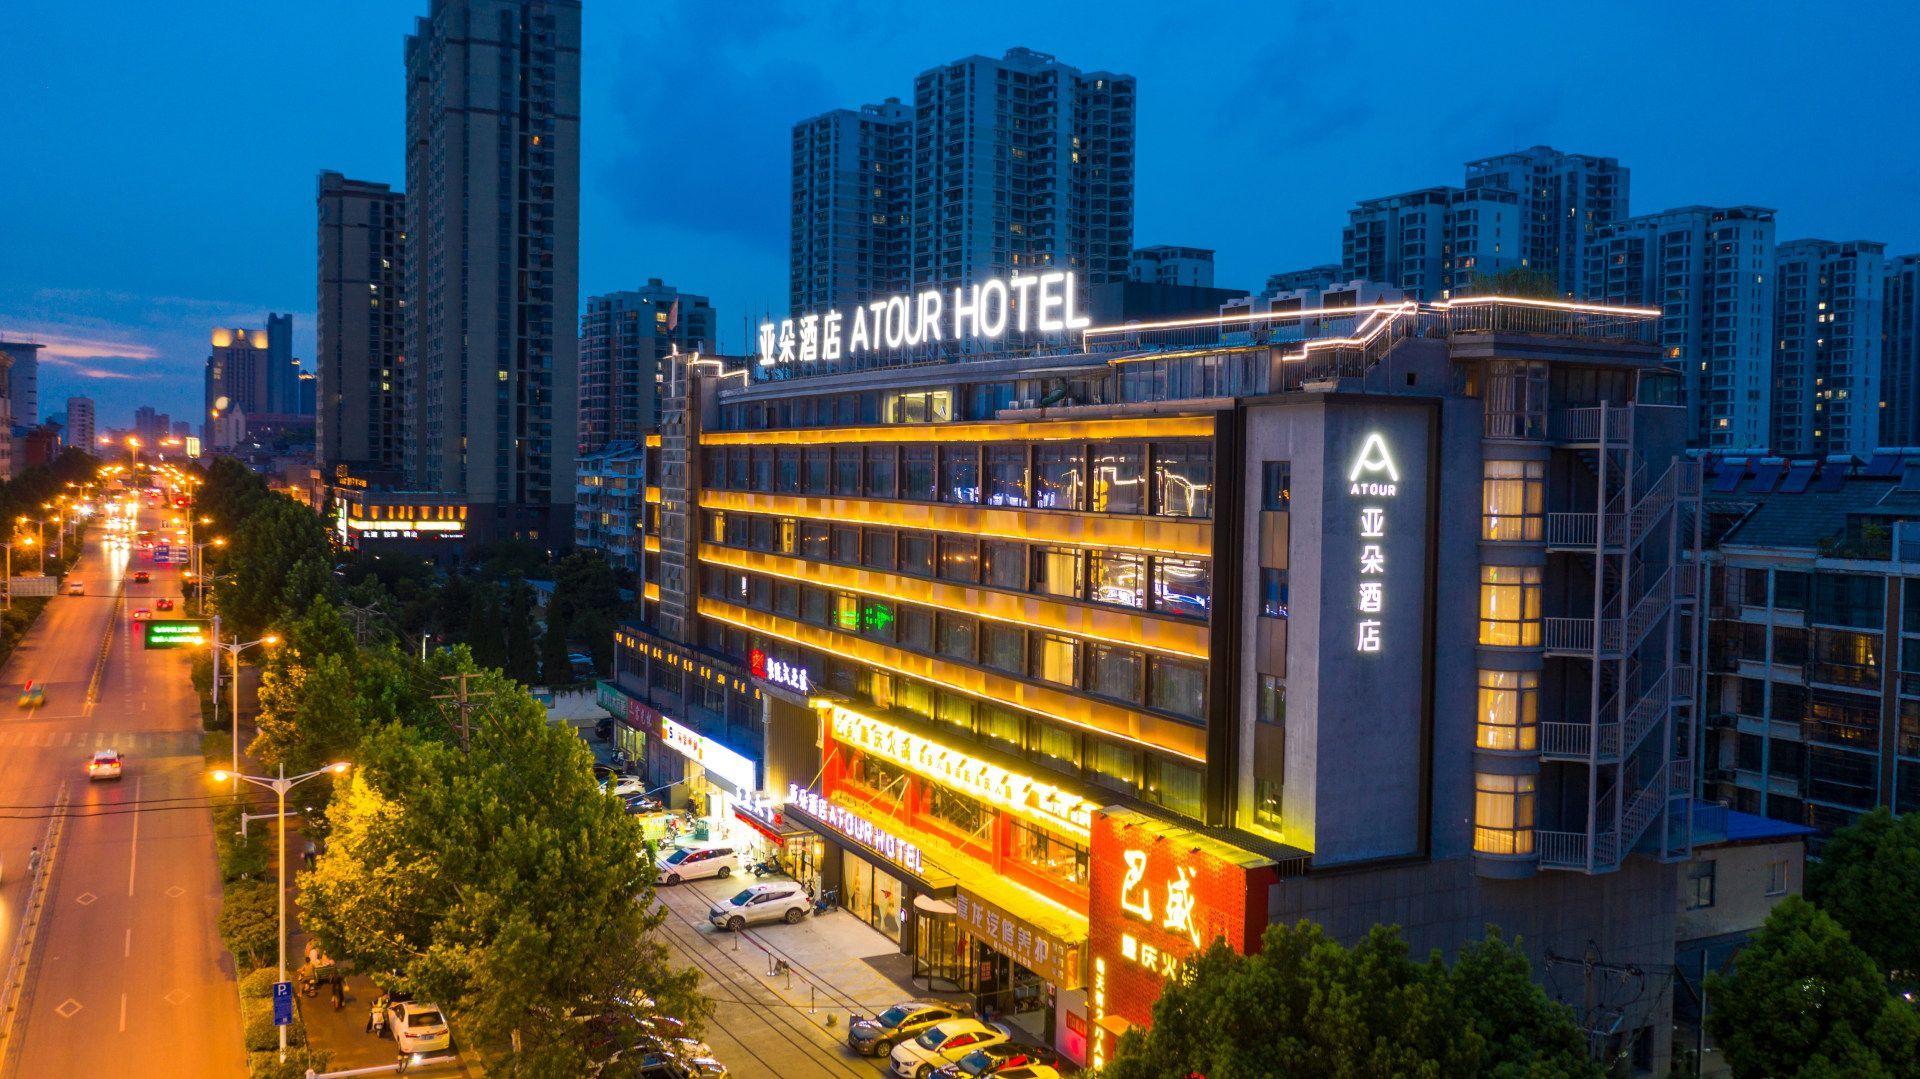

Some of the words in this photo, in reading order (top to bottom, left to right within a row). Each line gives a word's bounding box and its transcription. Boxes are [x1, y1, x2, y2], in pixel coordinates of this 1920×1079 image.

[759, 309, 843, 366] 亚朵酒店
[850, 290, 942, 353] ATOUR
[954, 271, 1091, 340] HOTEL
[1350, 483, 1397, 497] ATOUR
[1357, 509, 1385, 653] 亚朵酒店
[789, 783, 829, 821] 亚朵酒店
[829, 805, 873, 845] ATOUR
[875, 828, 924, 873] HOTEL
